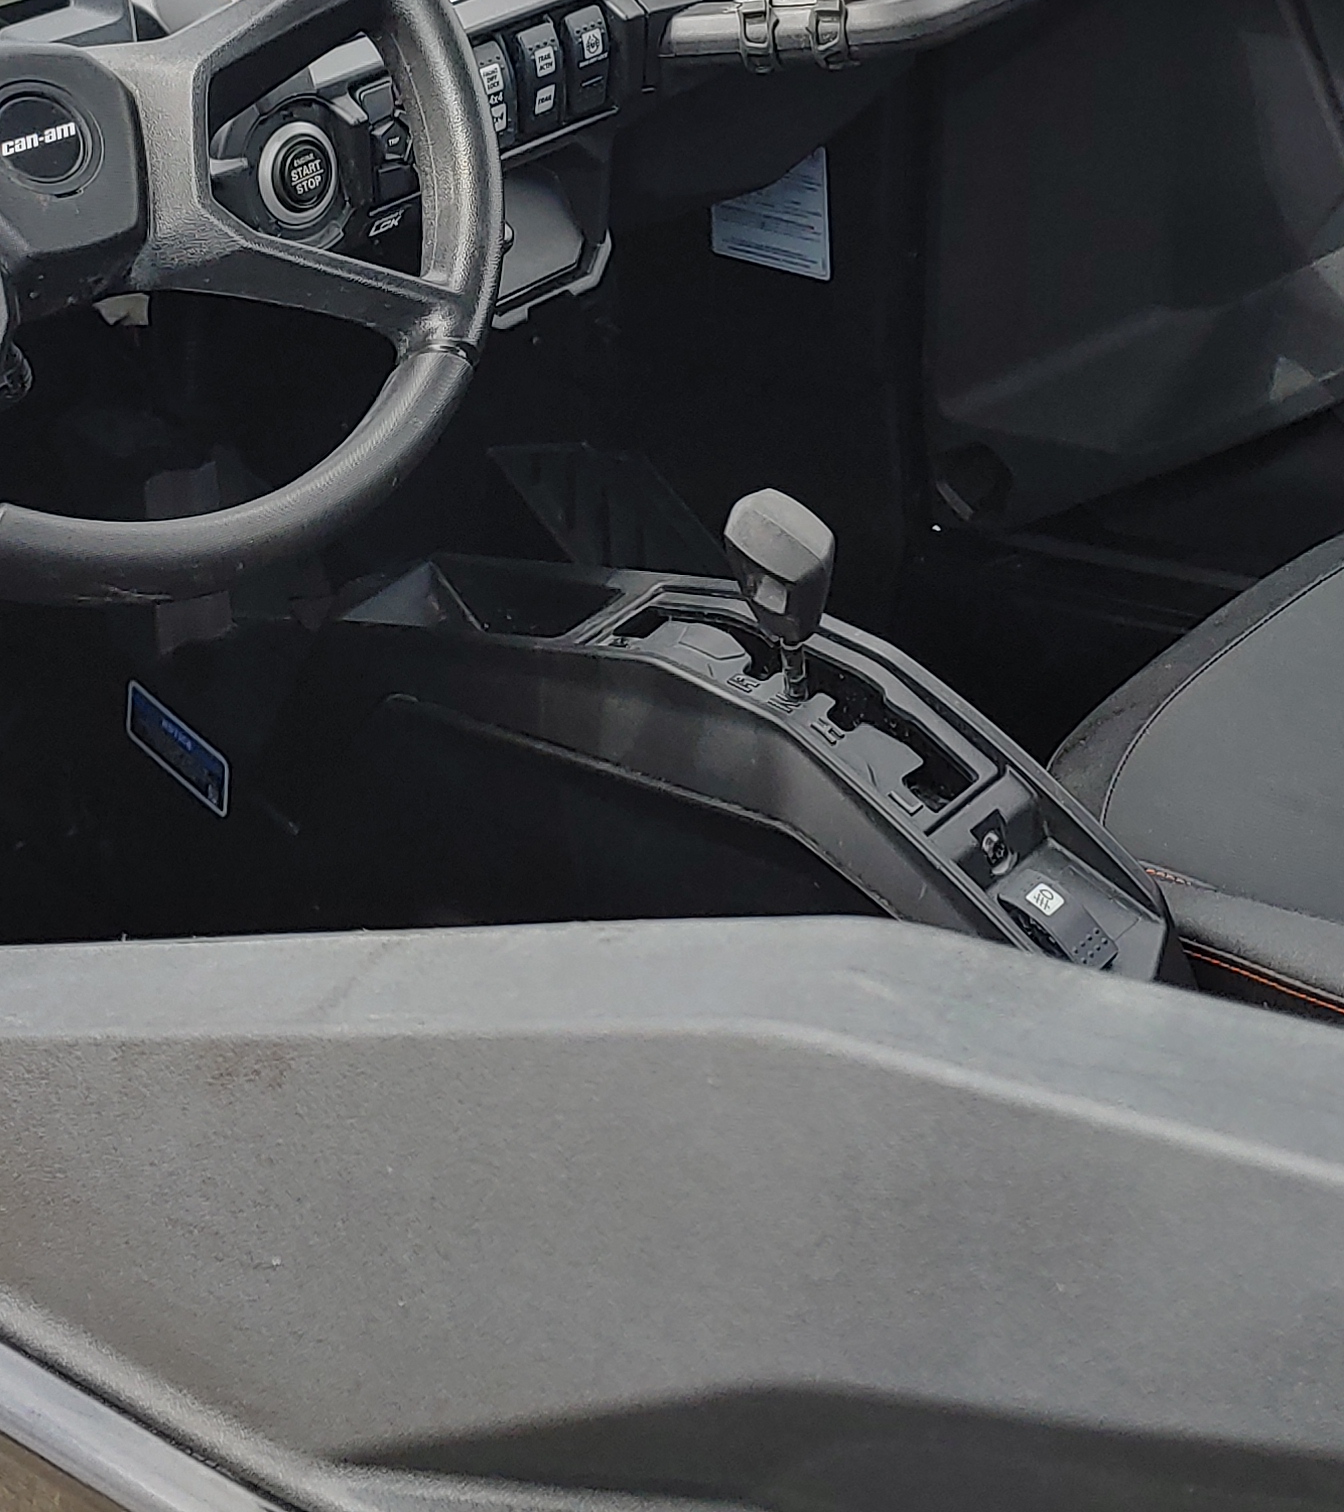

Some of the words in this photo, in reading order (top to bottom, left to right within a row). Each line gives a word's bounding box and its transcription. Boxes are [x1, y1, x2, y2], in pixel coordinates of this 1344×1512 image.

[1, 121, 76, 157] can-am
[291, 159, 321, 182] START
[296, 175, 322, 195] STOP
